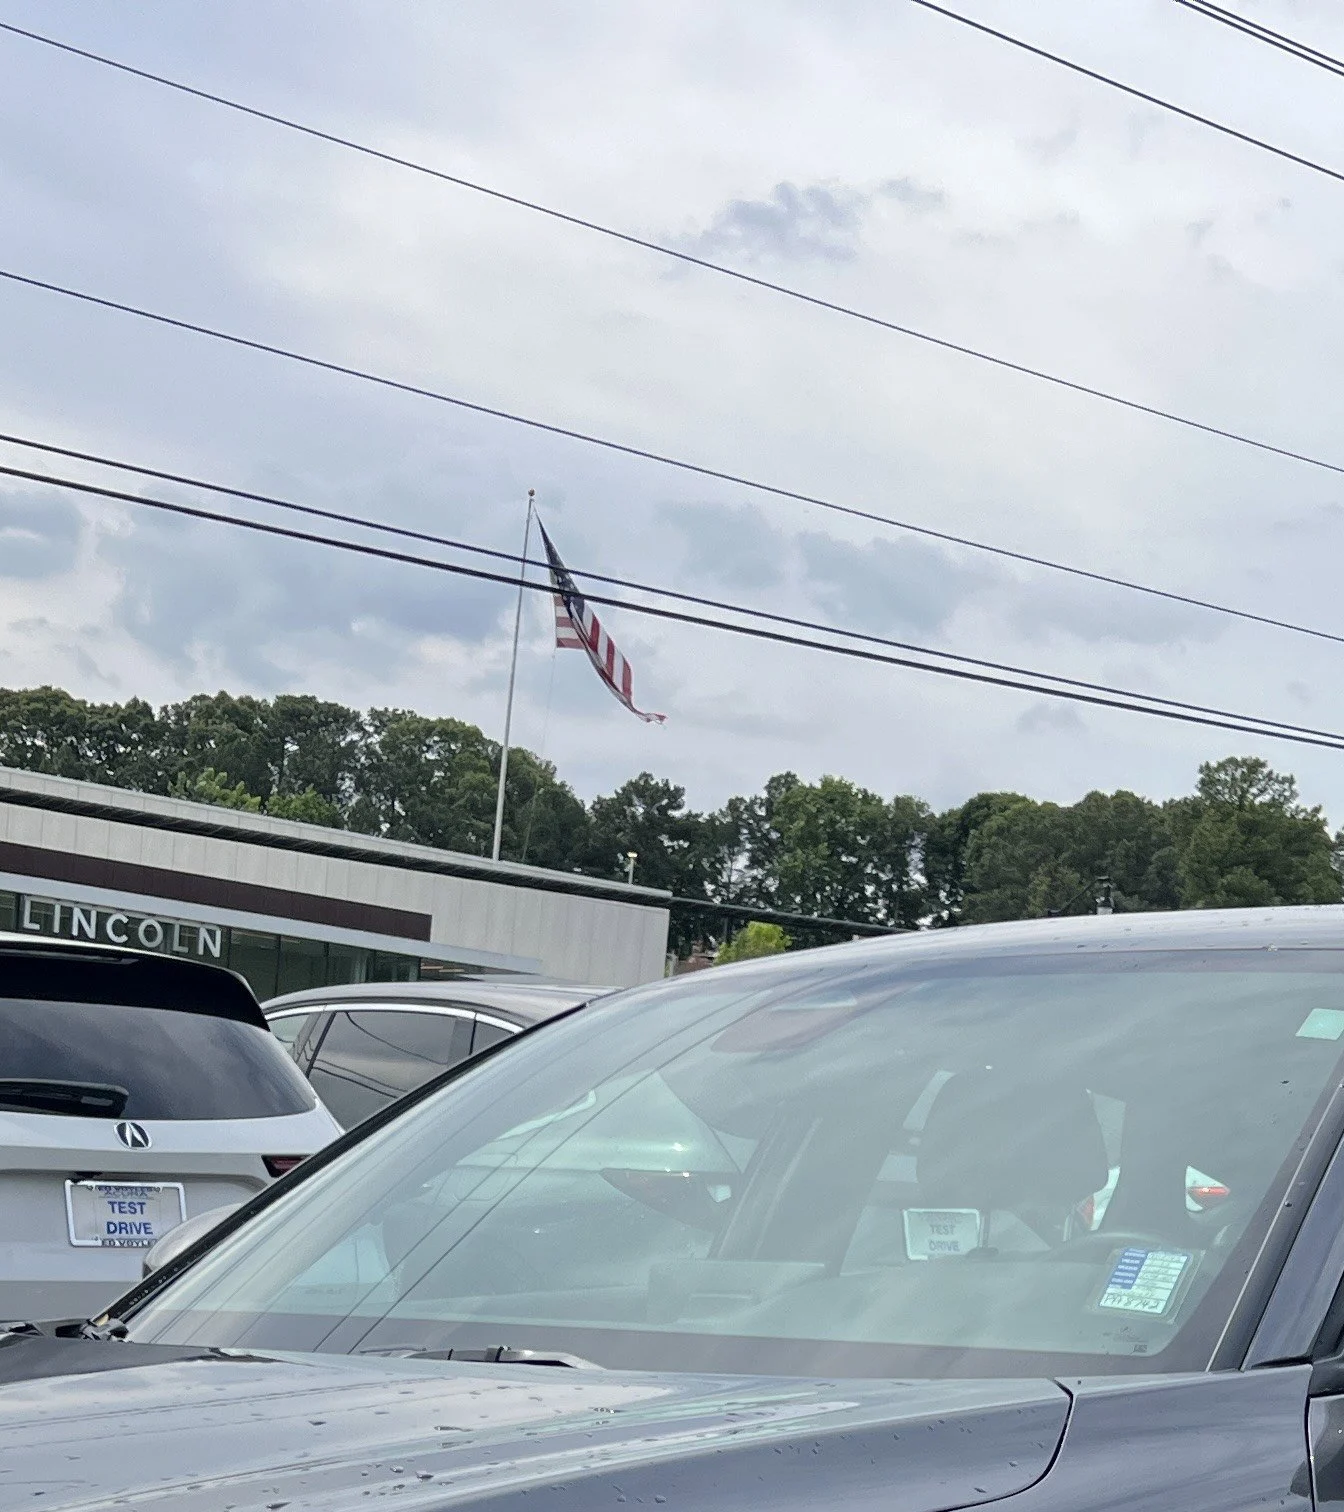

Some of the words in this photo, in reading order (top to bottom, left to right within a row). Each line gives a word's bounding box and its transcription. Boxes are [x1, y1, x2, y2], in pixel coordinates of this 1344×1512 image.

[23, 896, 222, 958] LINCOLN
[107, 1200, 147, 1215] TEST
[106, 1221, 154, 1236] DRIVE
